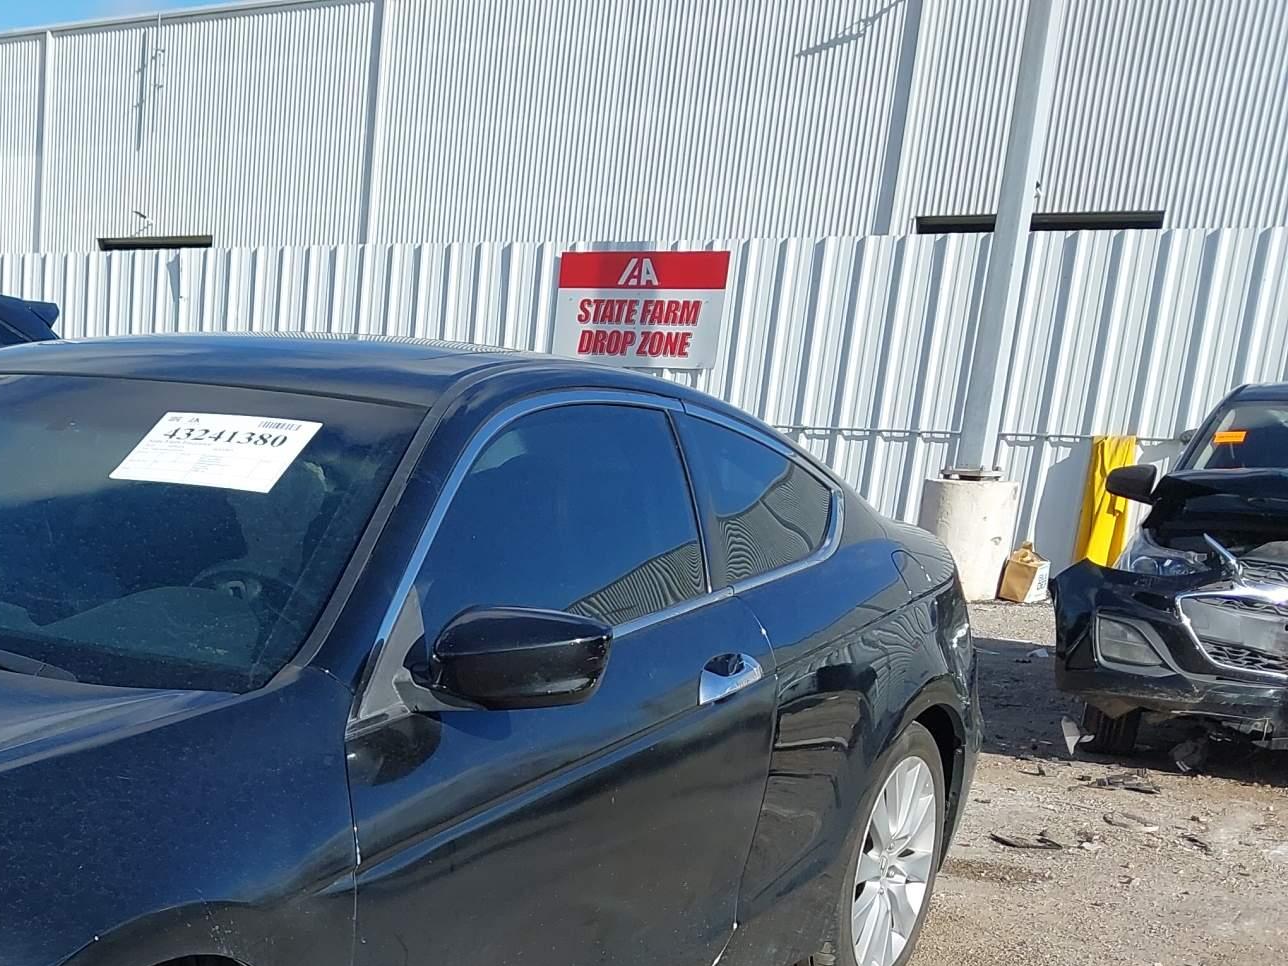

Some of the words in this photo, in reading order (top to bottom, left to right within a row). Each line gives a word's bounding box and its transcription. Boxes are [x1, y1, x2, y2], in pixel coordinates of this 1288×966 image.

[577, 298, 637, 326] STATE
[639, 299, 703, 327] FARM
[577, 329, 637, 357] DROP
[635, 331, 693, 358] ZONE
[163, 427, 288, 448] 43241380
